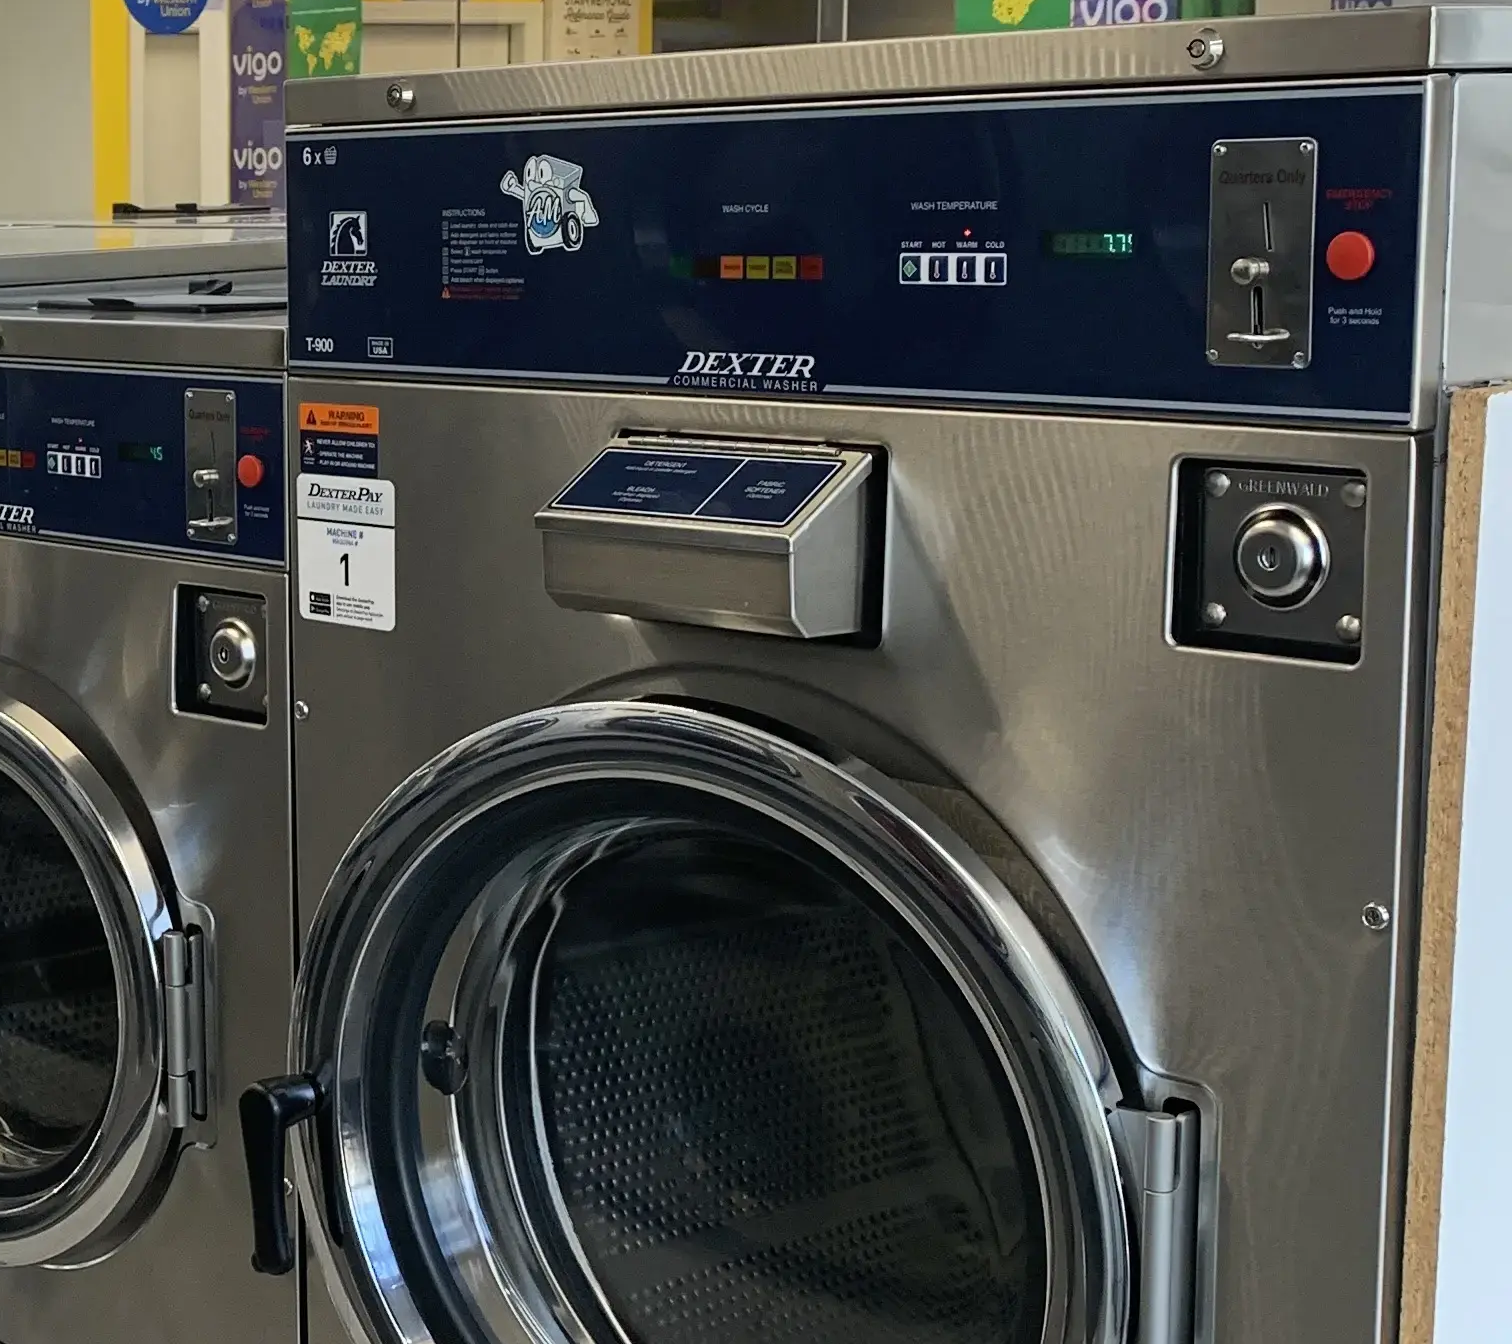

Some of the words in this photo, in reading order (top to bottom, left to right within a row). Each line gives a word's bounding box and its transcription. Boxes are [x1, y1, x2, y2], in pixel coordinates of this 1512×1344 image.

[160, 4, 191, 17] Union
[233, 45, 282, 81] vigo
[233, 140, 283, 176] vigo
[302, 146, 312, 166] 6
[314, 152, 322, 165] x
[1218, 170, 1273, 185] Quarters
[1276, 169, 1306, 186] Only
[722, 204, 743, 214] WASH
[745, 203, 769, 213] CYCLE
[910, 202, 935, 212] WASH
[937, 201, 999, 211] TEMPERATURE
[901, 240, 923, 248] START
[931, 240, 945, 248] HOT
[956, 240, 978, 248] WARM
[985, 240, 1005, 248] COLD
[321, 260, 375, 275] DEXTER
[321, 274, 377, 287] LAUNDRY
[1328, 307, 1347, 316] Push
[1349, 308, 1362, 316] and
[1364, 308, 1382, 317] Hold
[1348, 316, 1380, 325] seconds
[305, 337, 334, 353] T-900
[372, 346, 388, 355] USA
[678, 350, 816, 379] DEXTER
[673, 375, 757, 389] COMMERCIAL
[763, 379, 818, 392] WASHER
[328, 410, 365, 422] WARNING
[644, 460, 687, 468] DETERGENT
[744, 486, 787, 495] SOFTENER
[757, 480, 786, 488] FABRIC
[1239, 478, 1329, 498] GREENWALD
[307, 501, 340, 512] LAUNDRY
[342, 504, 363, 514] MADE
[365, 506, 384, 516] EASY
[6, 519, 37, 534] WASHER
[326, 527, 357, 539] MACHINE
[340, 553, 350, 586] 1
